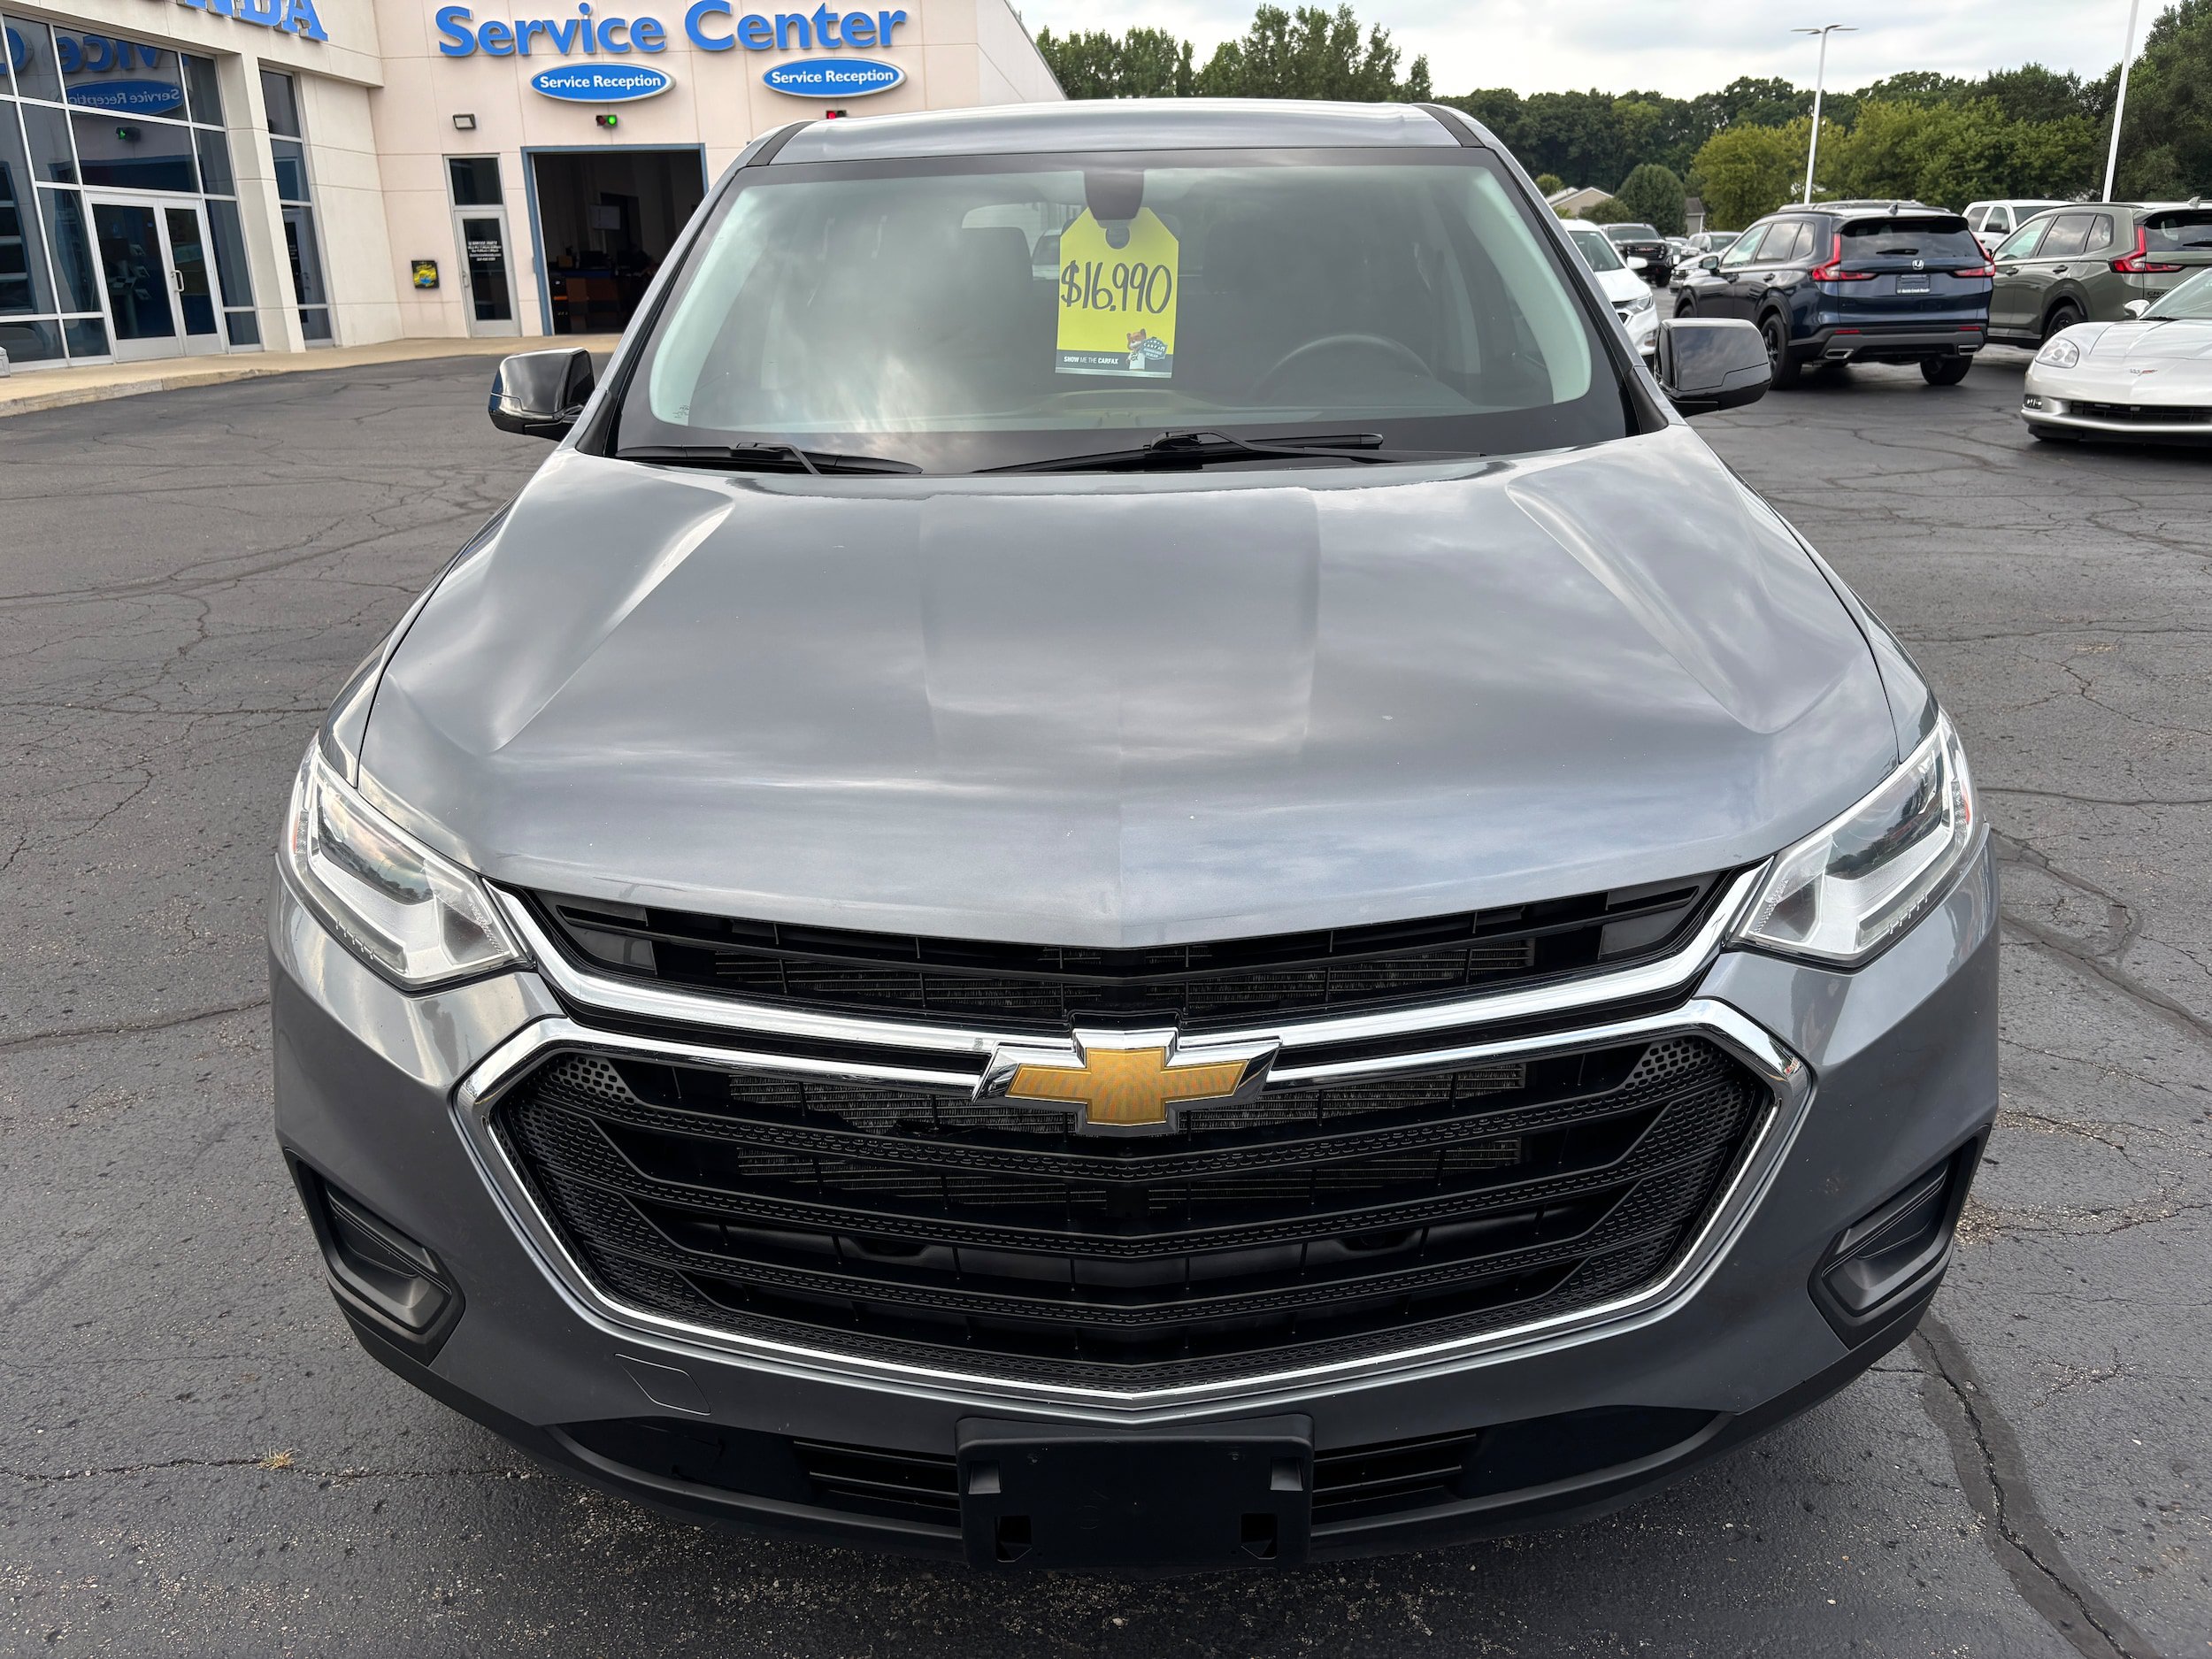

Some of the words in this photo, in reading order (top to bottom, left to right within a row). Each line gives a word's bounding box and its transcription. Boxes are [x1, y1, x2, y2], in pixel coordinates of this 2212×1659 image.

[434, 3, 667, 58] Service
[684, 0, 908, 50] Center
[539, 74, 591, 88] Service
[593, 73, 662, 90] Reception
[772, 70, 823, 84] Service
[825, 69, 895, 85] Reception
